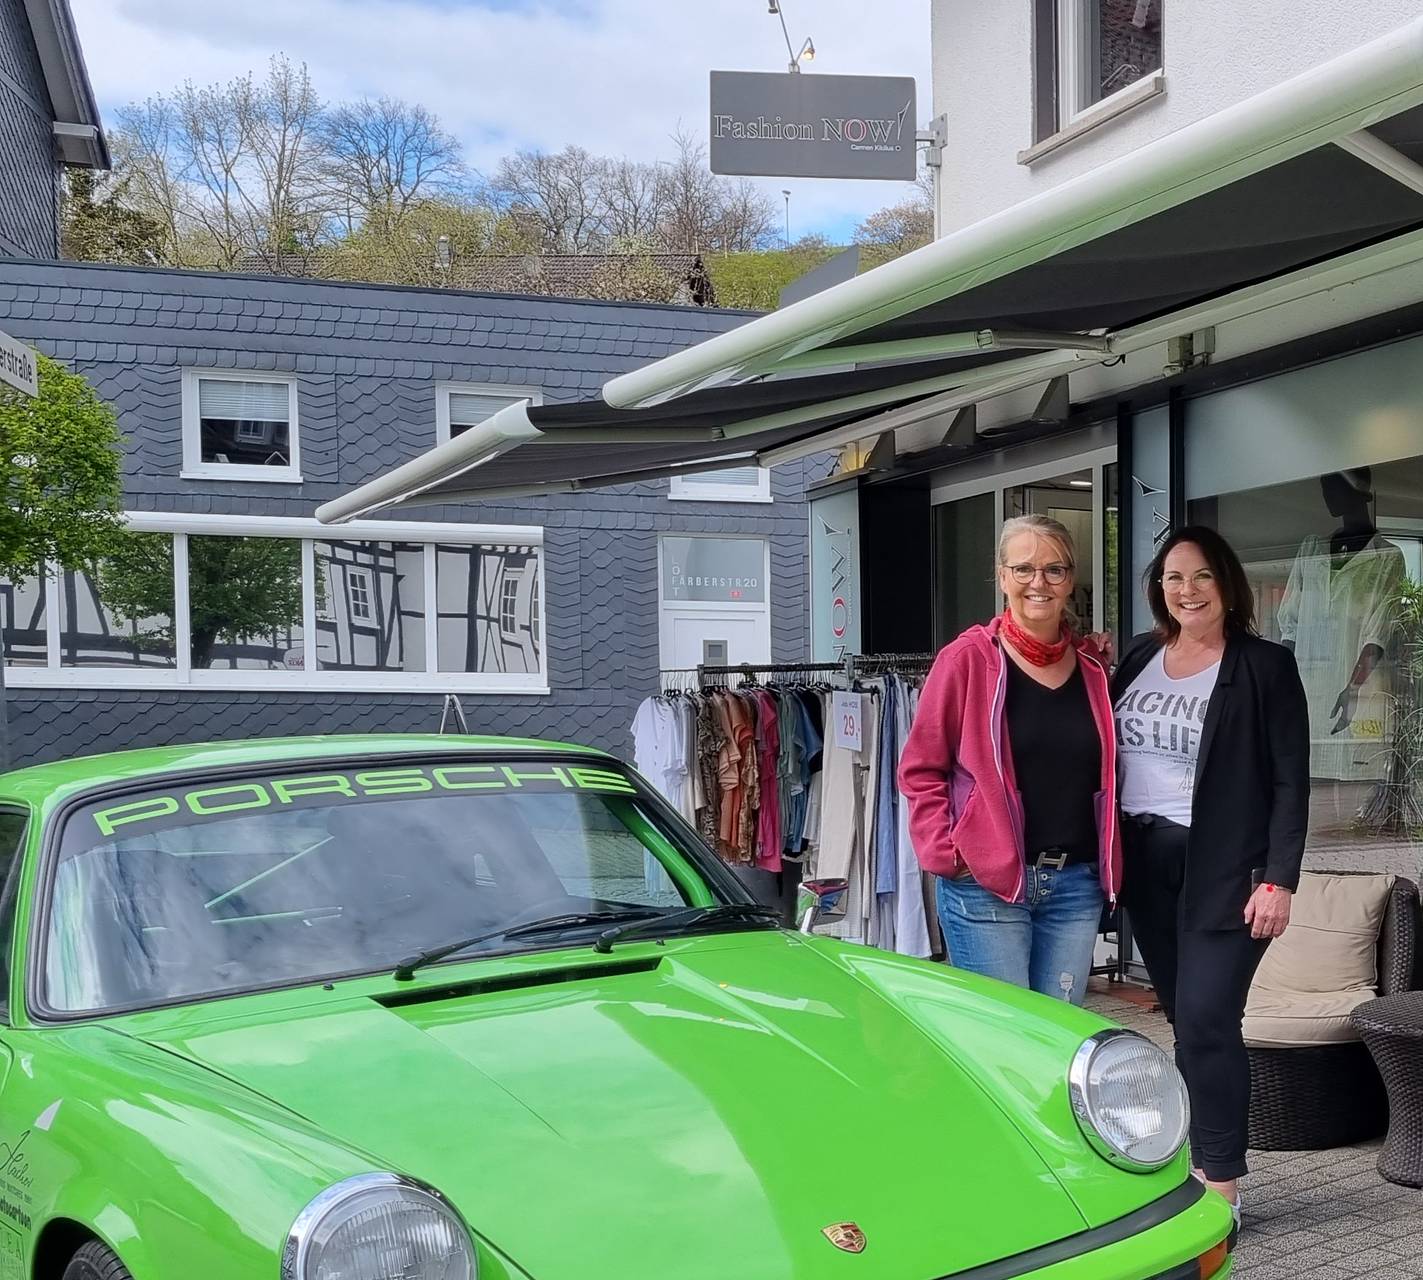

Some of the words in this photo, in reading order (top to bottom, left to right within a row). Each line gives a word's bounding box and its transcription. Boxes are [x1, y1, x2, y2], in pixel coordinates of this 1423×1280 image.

[714, 114, 814, 141] Fashion
[1115, 689, 1208, 723] ACIN
[1153, 720, 1199, 754] LIF
[93, 766, 636, 836] PORSCHE
